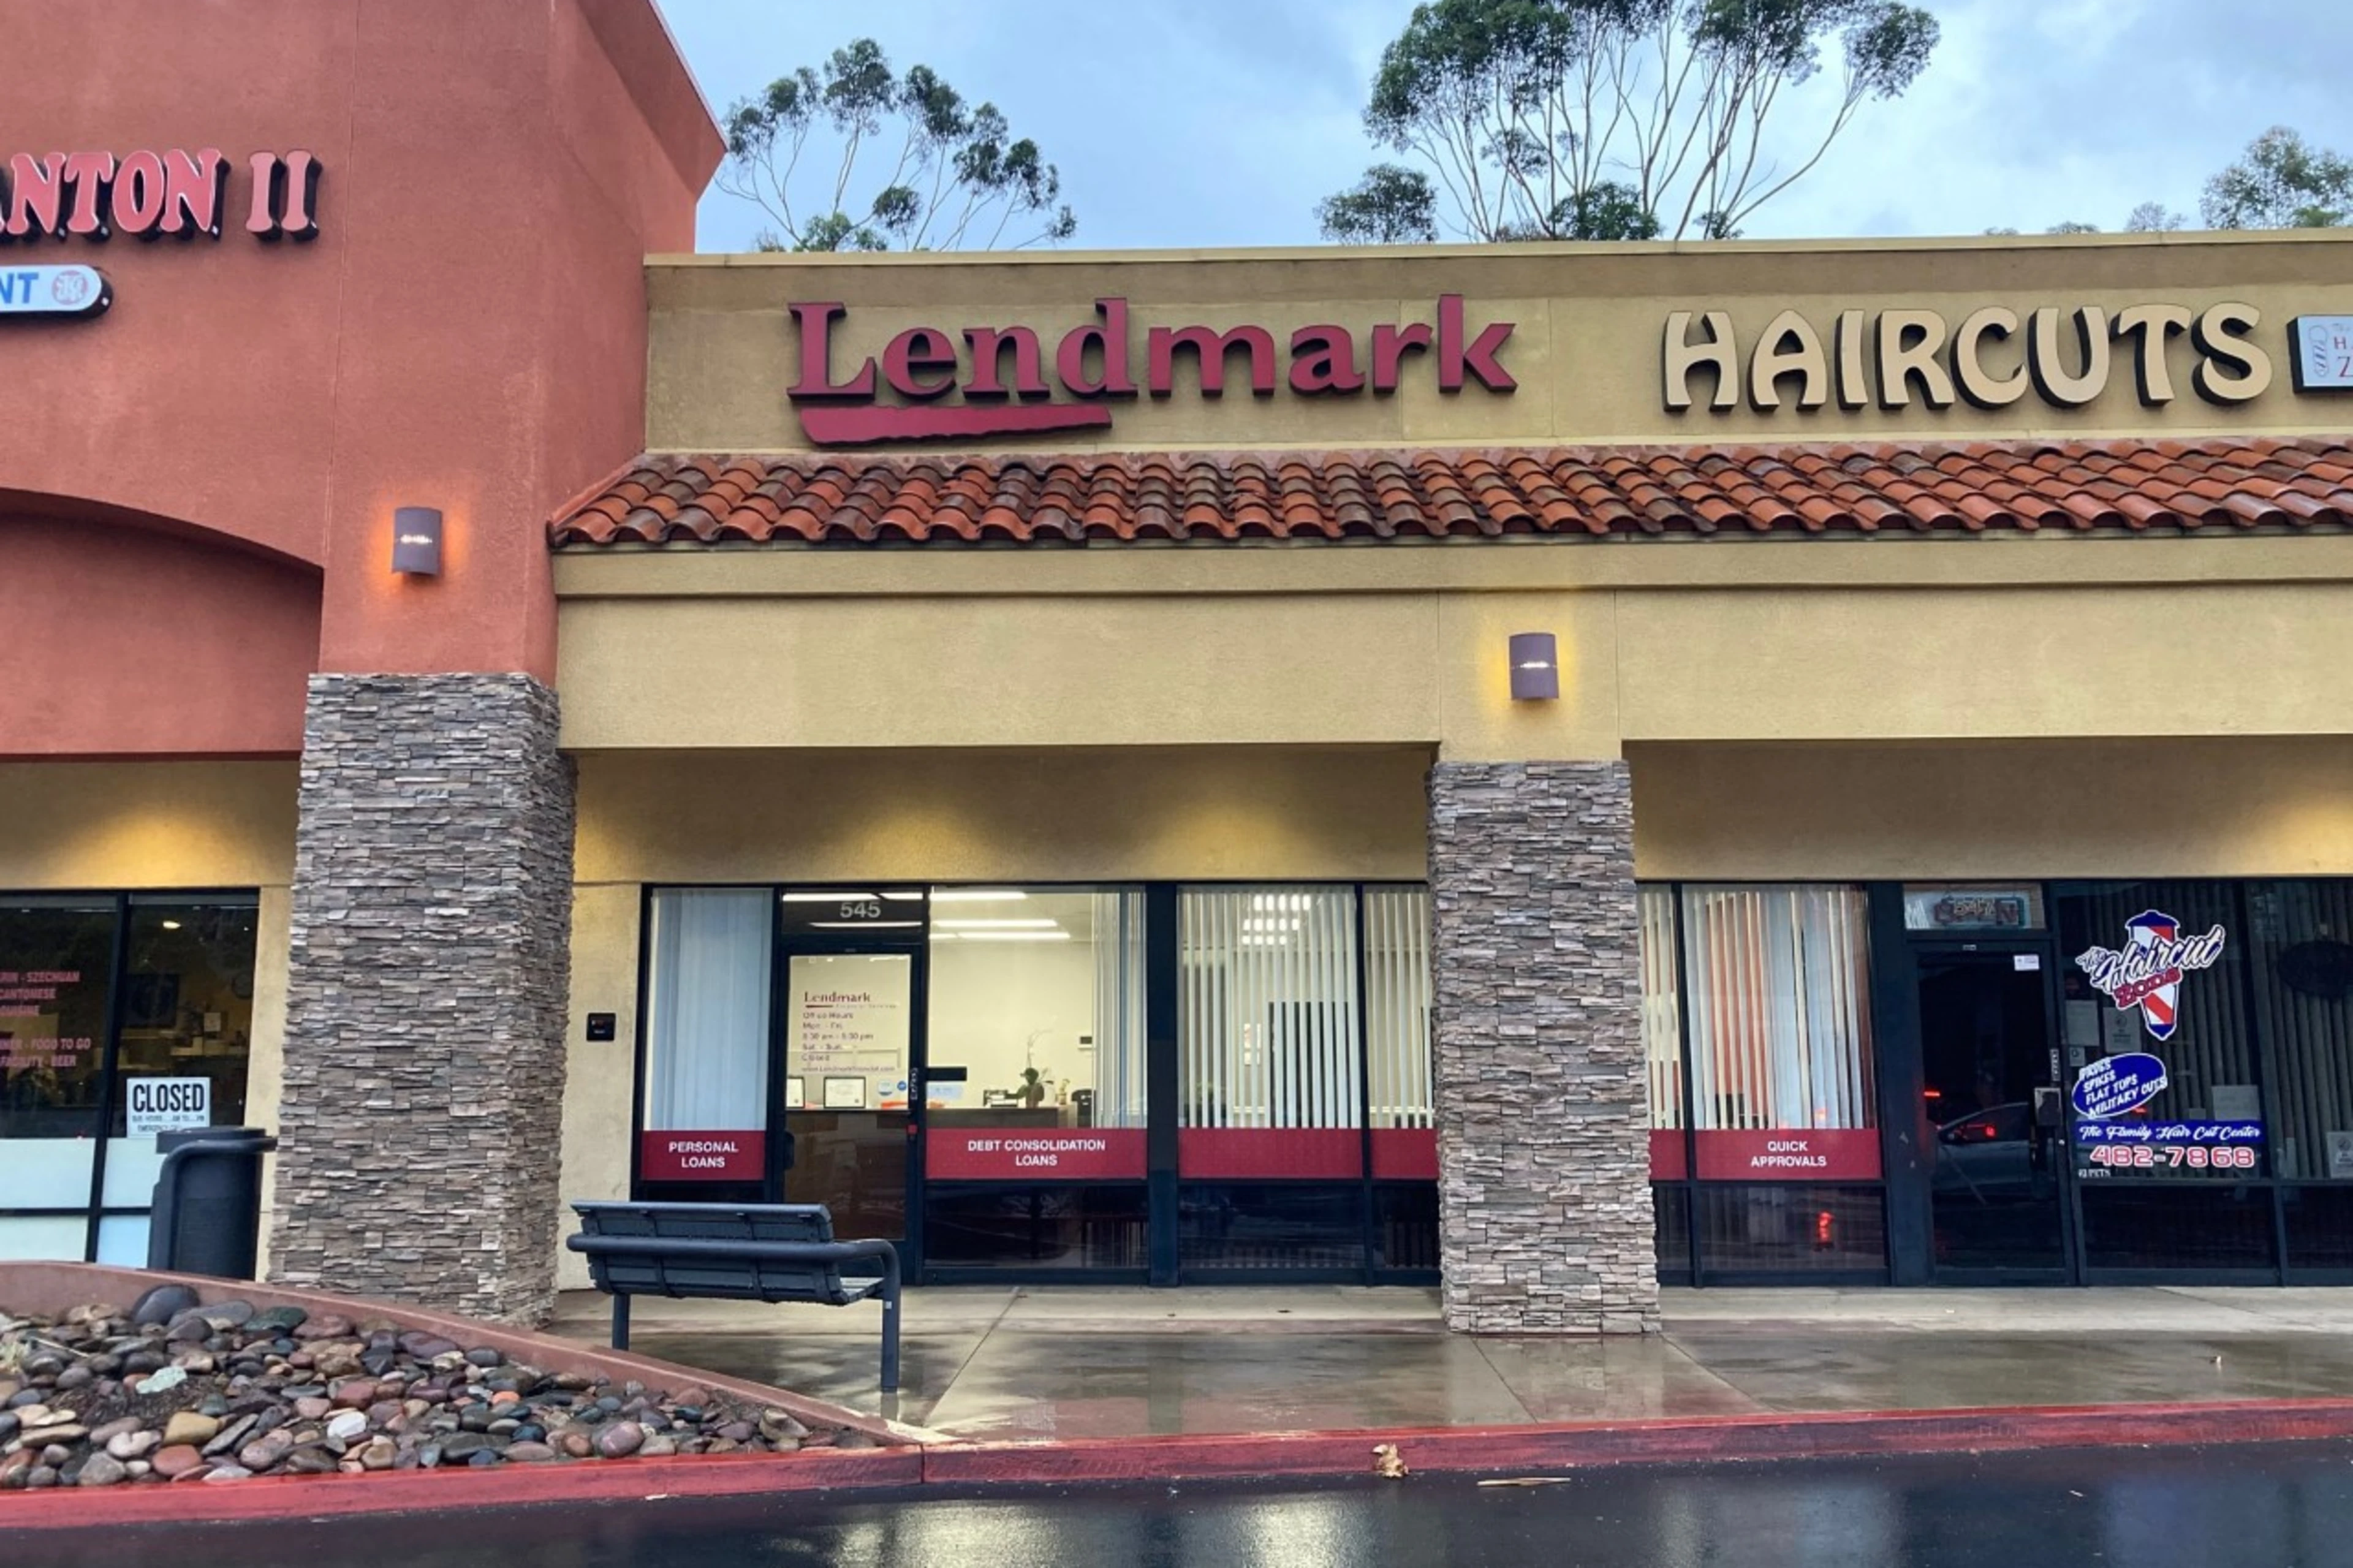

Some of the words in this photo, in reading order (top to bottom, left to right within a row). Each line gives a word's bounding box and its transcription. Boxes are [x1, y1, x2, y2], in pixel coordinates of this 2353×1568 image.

[788, 294, 1517, 400] Lendmark
[1662, 302, 2272, 412] HAIRCUTS
[839, 901, 881, 918] 545
[2090, 924, 2226, 994] Haircut
[804, 991, 871, 1002] Lendmark
[60, 1038, 74, 1050] TO
[76, 1038, 91, 1050] GO
[132, 1083, 205, 1113] CLOSED
[2085, 1085, 2110, 1105] FLAT
[2112, 1074, 2139, 1093] TOPS
[2088, 1086, 2139, 1119] MILITARY
[2079, 1126, 2102, 1140] The
[2106, 1123, 2152, 1141] Family
[2156, 1124, 2191, 1140] Hair
[2193, 1126, 2219, 1140] Cut
[2219, 1125, 2260, 1140] Center
[668, 1141, 739, 1153] PERSONAL
[968, 1140, 1001, 1151] DEBT
[1004, 1139, 1106, 1151] CONSOLIDATION
[1767, 1140, 1808, 1152] QUICK
[681, 1156, 726, 1168] LOANS
[1015, 1154, 1058, 1165] LOANS
[1751, 1156, 1827, 1167] APPROVALS
[2090, 1145, 2255, 1168] 482-7868
